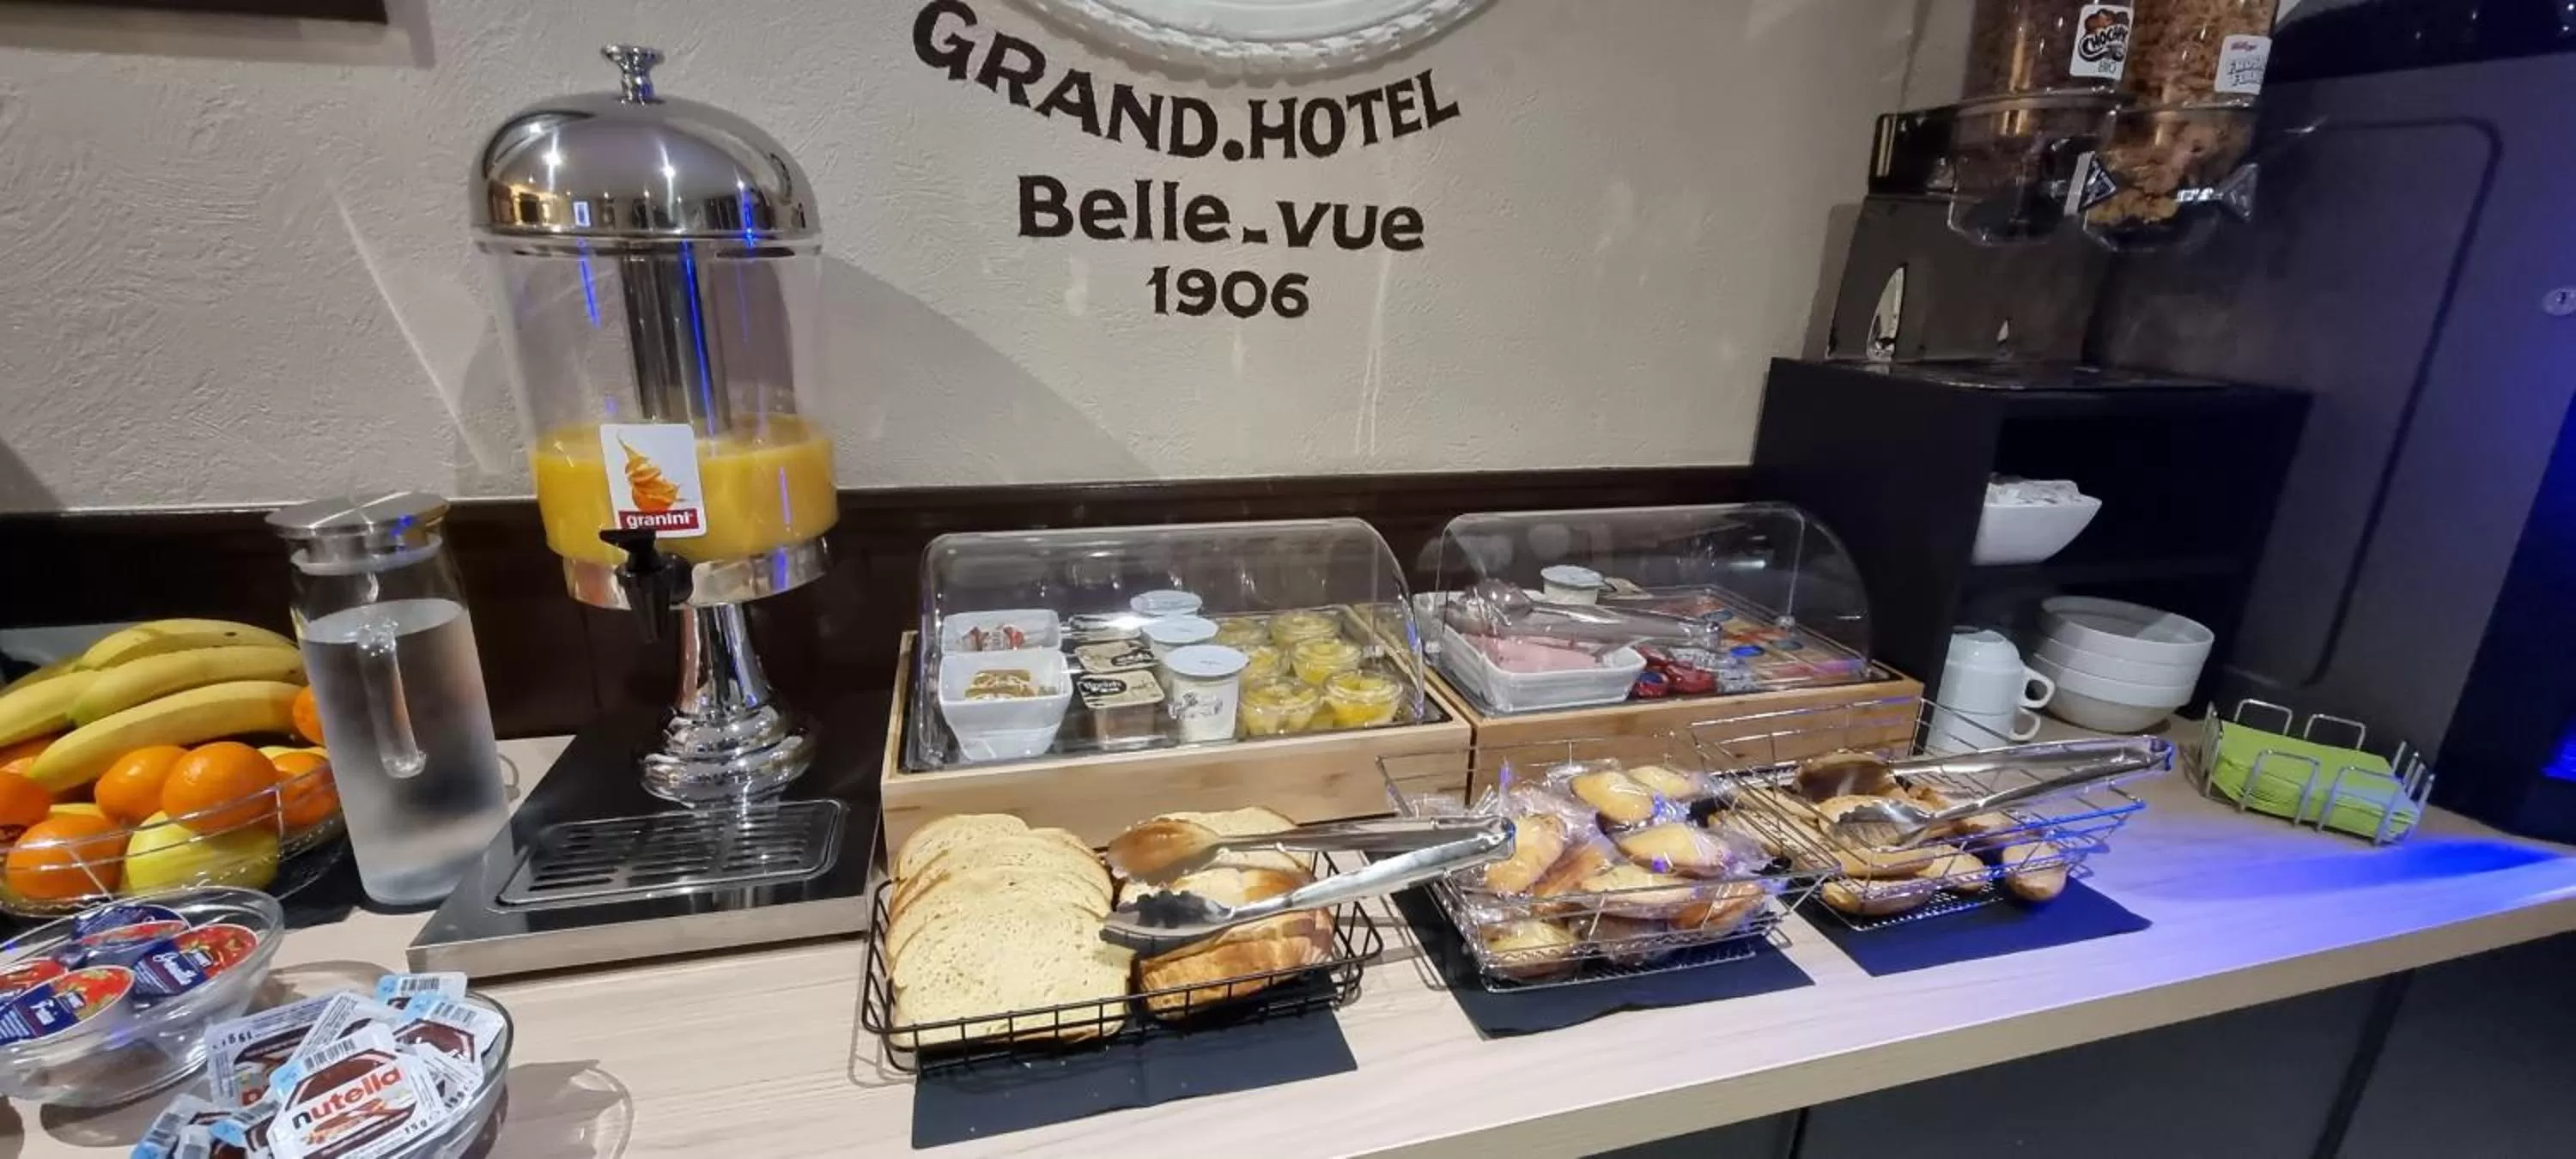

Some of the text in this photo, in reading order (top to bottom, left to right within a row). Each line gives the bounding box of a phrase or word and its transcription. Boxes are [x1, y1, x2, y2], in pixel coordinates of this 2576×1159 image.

[1146, 265, 1310, 319] 1906
[626, 510, 693, 529] granini
[292, 1067, 401, 1130] nutella
